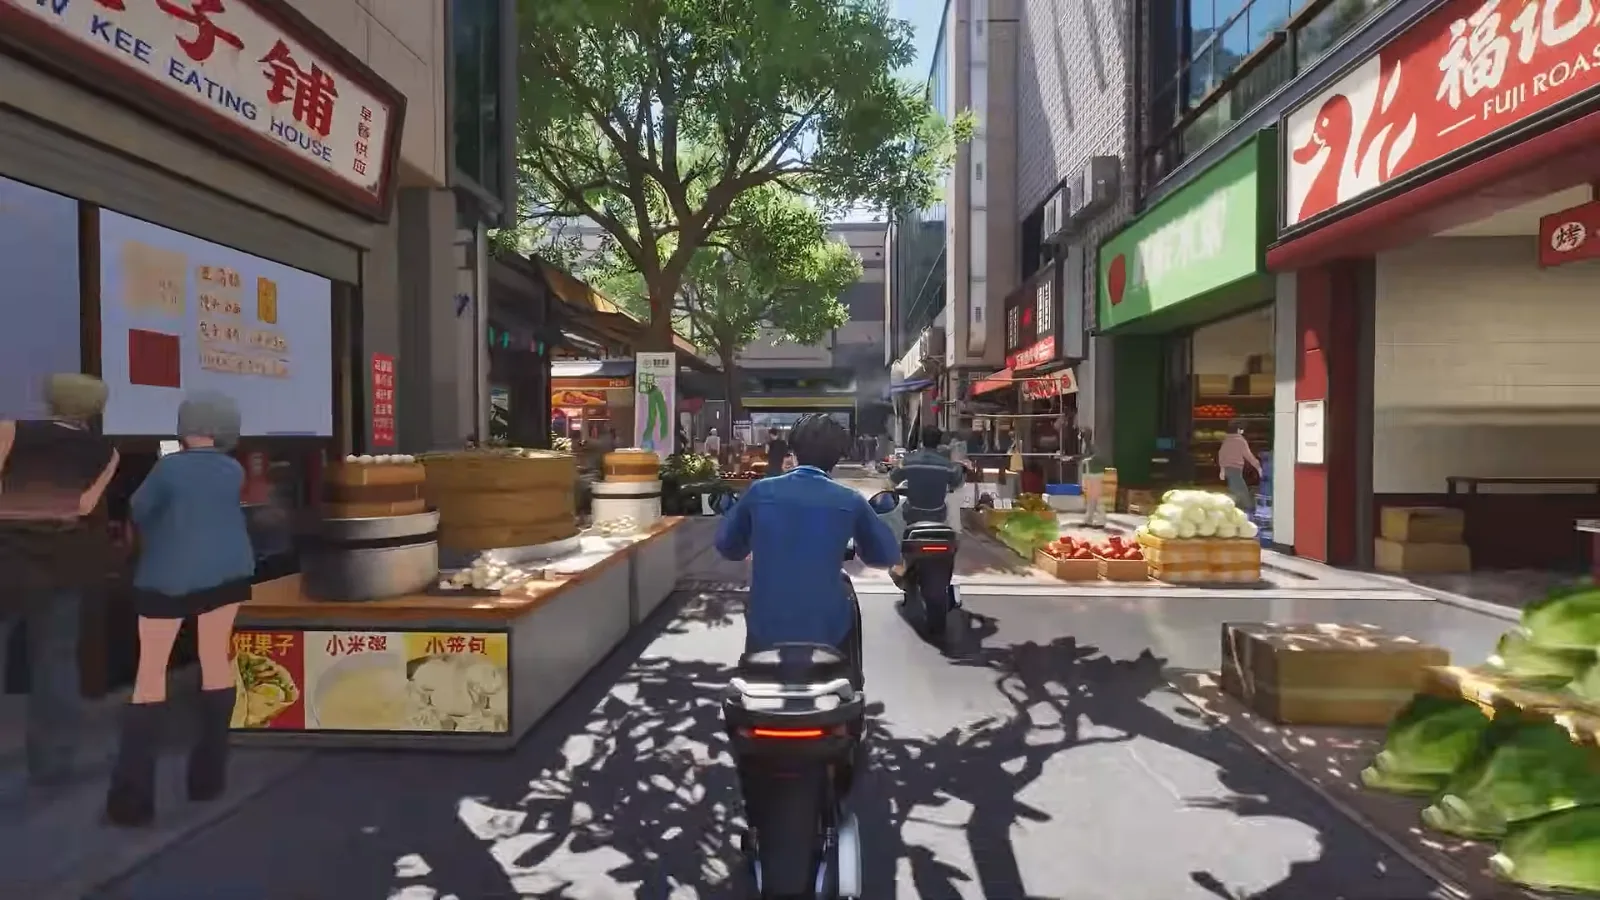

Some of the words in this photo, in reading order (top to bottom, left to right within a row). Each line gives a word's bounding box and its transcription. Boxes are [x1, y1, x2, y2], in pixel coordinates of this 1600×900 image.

[91, 15, 152, 64] KEE
[168, 57, 257, 120] EATING
[270, 116, 332, 163] HOUSE
[1483, 83, 1526, 120] FUJI
